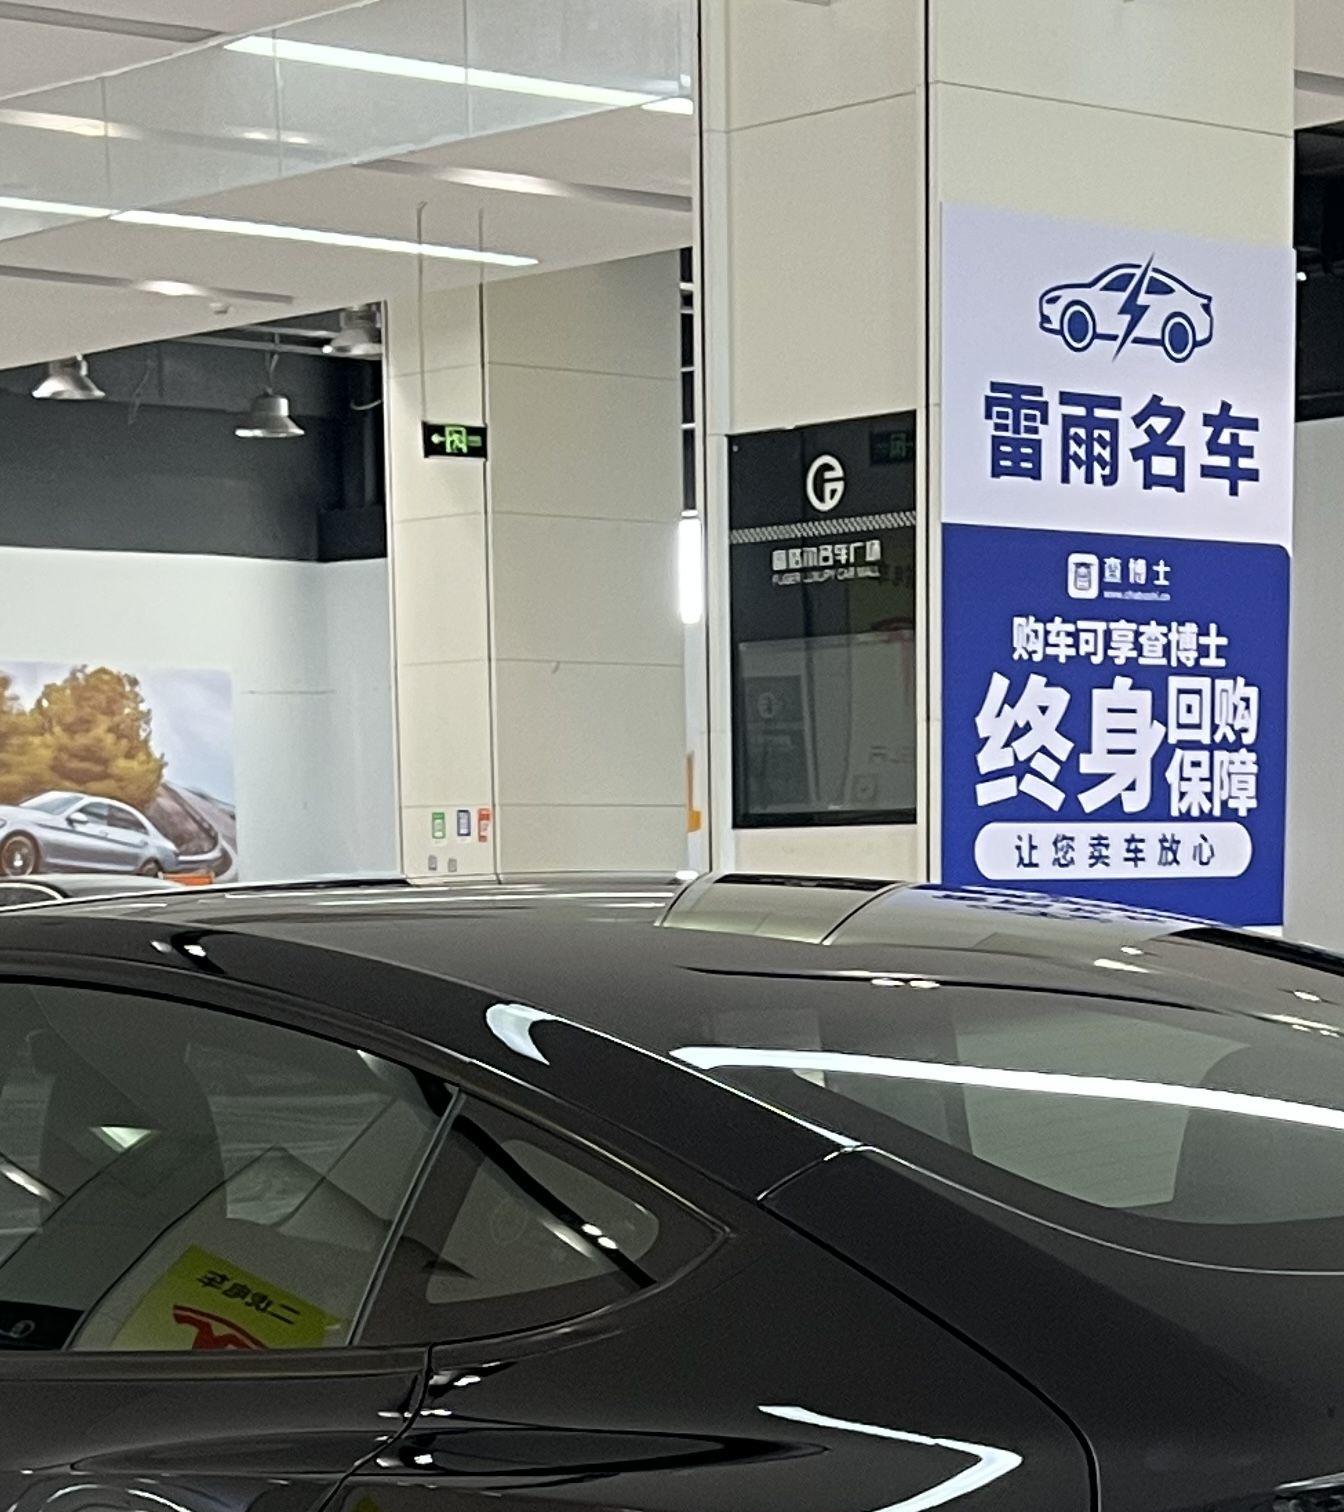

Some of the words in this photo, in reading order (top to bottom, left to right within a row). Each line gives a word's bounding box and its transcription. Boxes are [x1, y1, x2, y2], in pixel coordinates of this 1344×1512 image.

[984, 381, 1260, 496] 雷雨名车
[1012, 616, 1228, 667] 购车可享查博士
[975, 671, 1167, 814] 终身
[1167, 676, 1259, 745] 回购
[1165, 748, 1259, 817] 保障
[1015, 833, 1215, 868] 让您卖车放心
